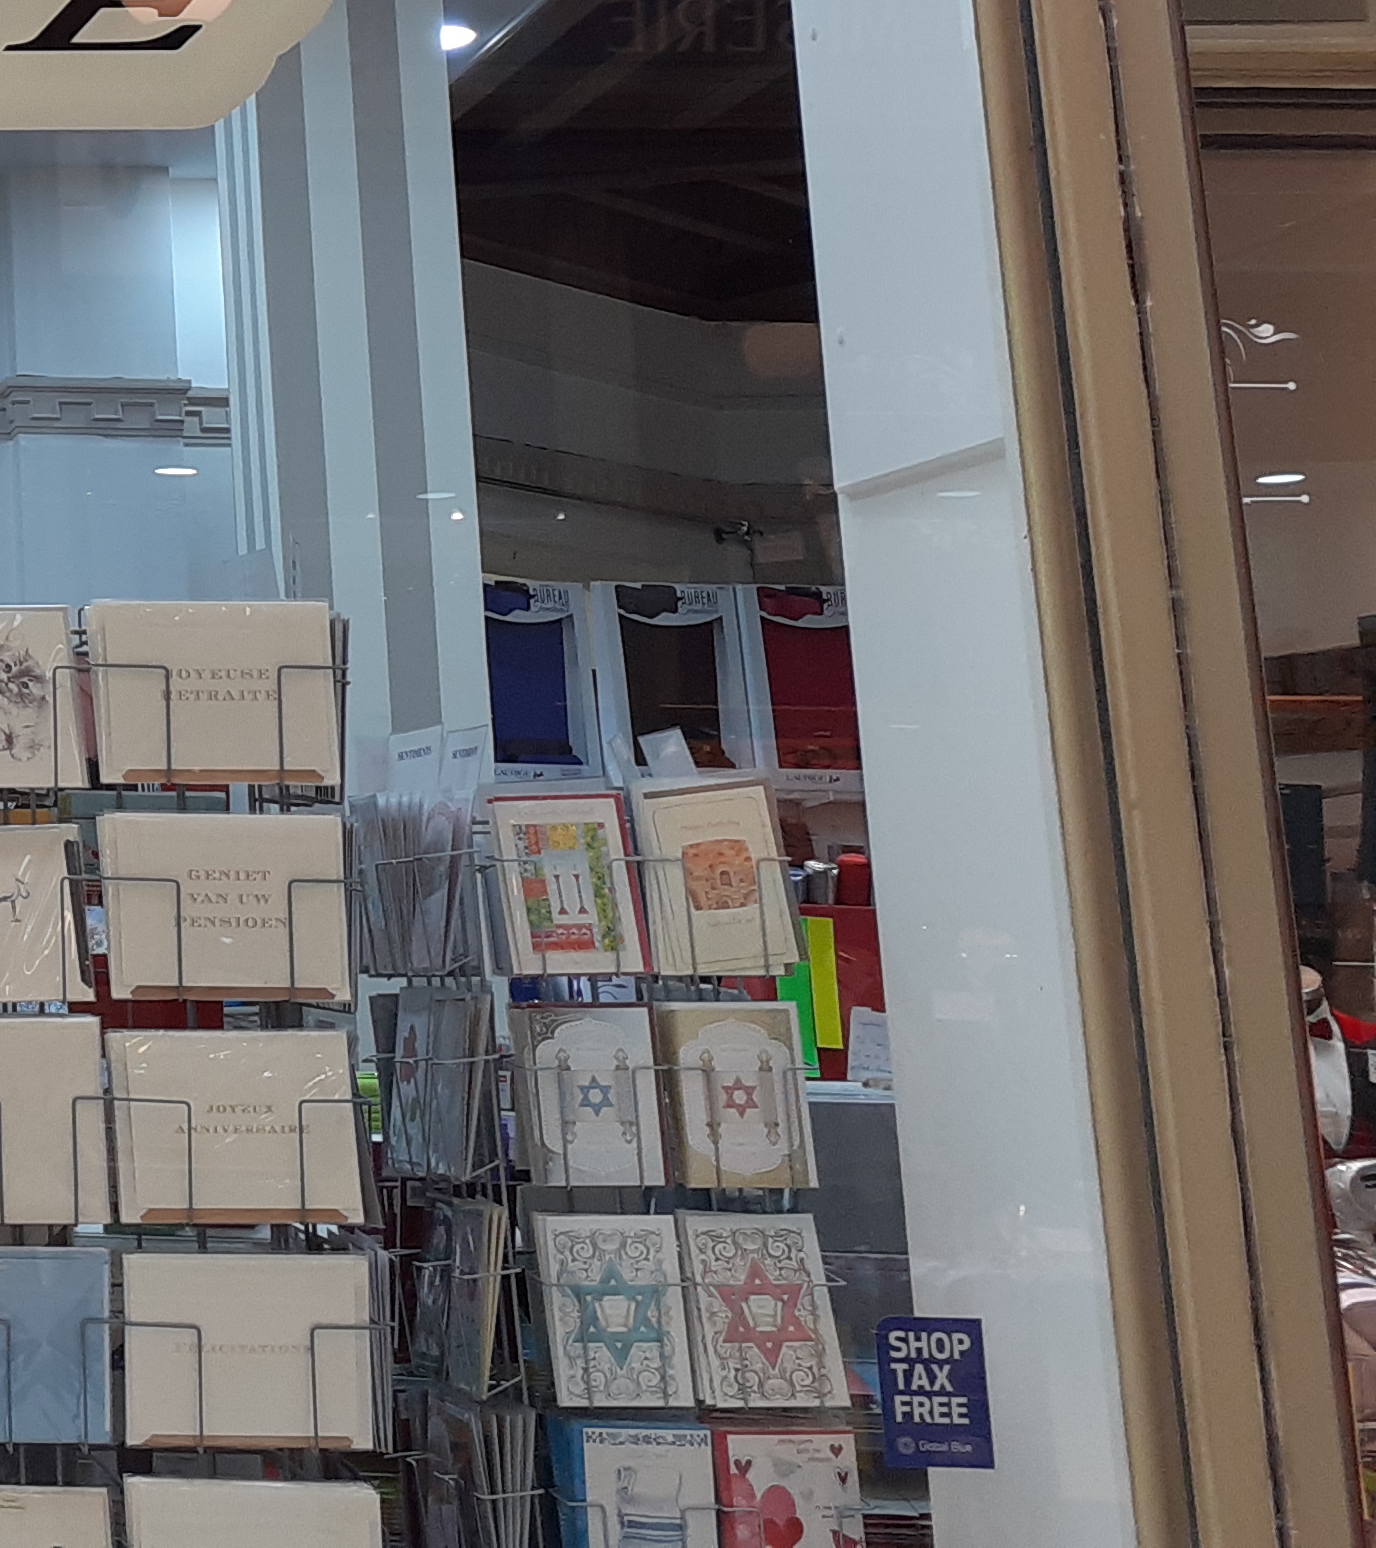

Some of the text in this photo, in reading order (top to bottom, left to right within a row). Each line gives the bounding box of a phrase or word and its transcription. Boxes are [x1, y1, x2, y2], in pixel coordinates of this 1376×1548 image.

[187, 868, 271, 882] GENIET
[188, 892, 272, 906] VAN UW
[206, 1103, 275, 1114] JOYEUX
[888, 1330, 971, 1360] SHOP
[890, 1362, 954, 1393] TAX
[893, 1394, 971, 1425] FREE
